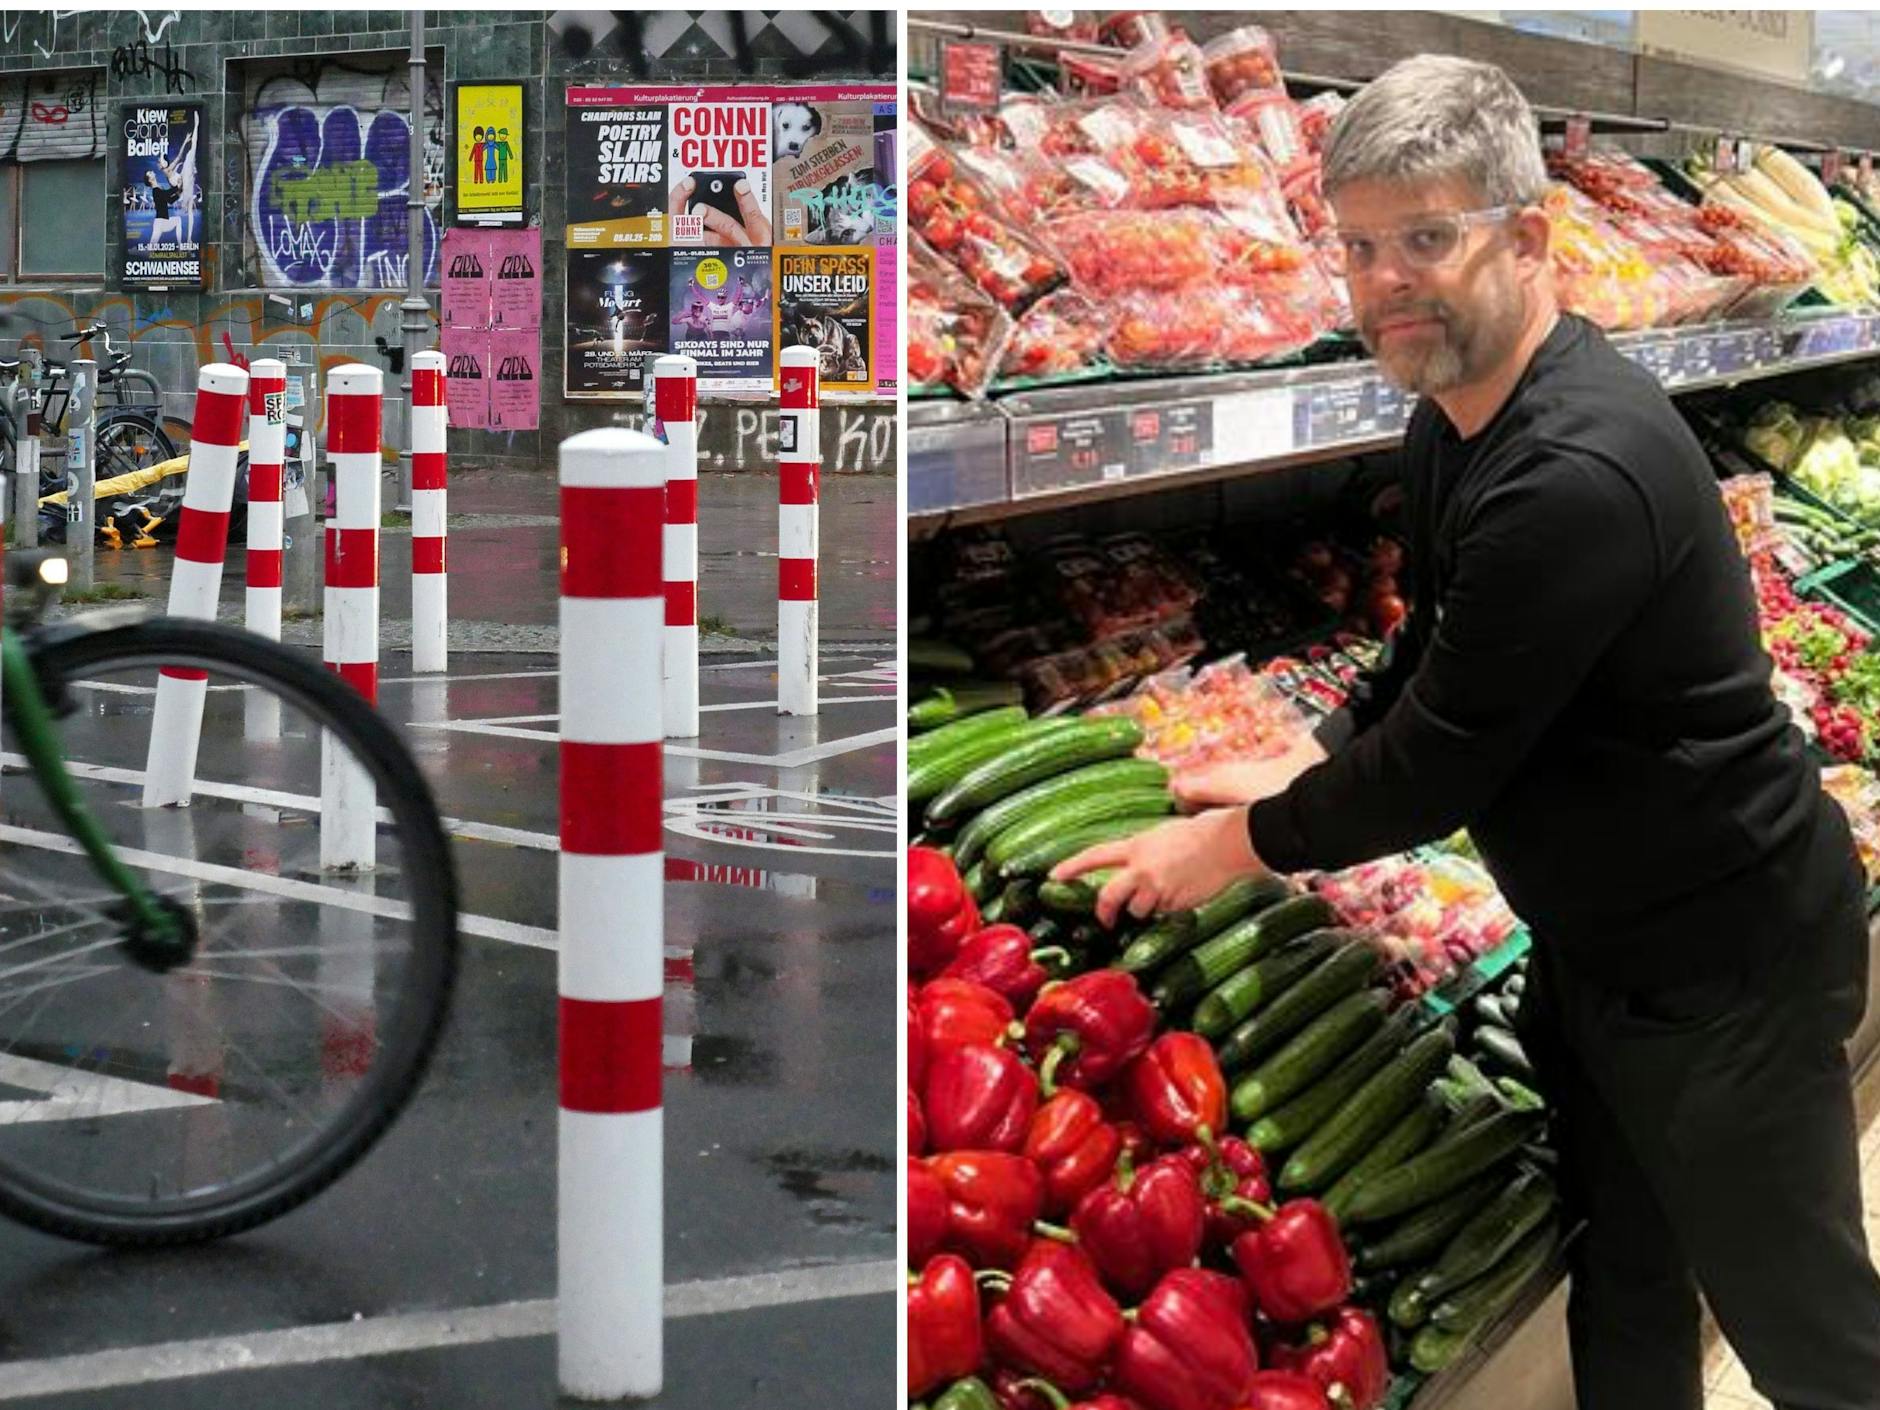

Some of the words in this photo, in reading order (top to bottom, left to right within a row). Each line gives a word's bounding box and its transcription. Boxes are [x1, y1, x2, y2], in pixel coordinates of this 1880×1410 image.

[634, 94, 698, 102] Kulturplakatierung
[137, 108, 168, 124] Kiew
[580, 112, 636, 122] CHAMPIONS
[636, 112, 662, 120] SLAM
[674, 106, 767, 136] CONNI
[124, 119, 169, 139] Grand
[598, 124, 662, 141] POETRY
[128, 138, 169, 156] Ballett
[598, 140, 662, 162] SLAM
[672, 149, 680, 158] &
[682, 139, 767, 168] CLYDE
[790, 158, 811, 178] ZUM
[809, 138, 848, 168] STERBEN
[598, 163, 662, 184] STARS
[675, 216, 701, 226] VOLKS
[180, 242, 199, 250] BERLIN
[734, 250, 746, 268] 6
[784, 258, 816, 274] DEIN
[820, 257, 866, 274] SPASS
[126, 261, 200, 276] SCHWANENSEE
[784, 275, 831, 292] UNSER
[836, 275, 866, 292] LEID
[598, 297, 642, 308] Moart
[674, 341, 718, 349] SIXDAYS
[746, 340, 769, 348] NUR
